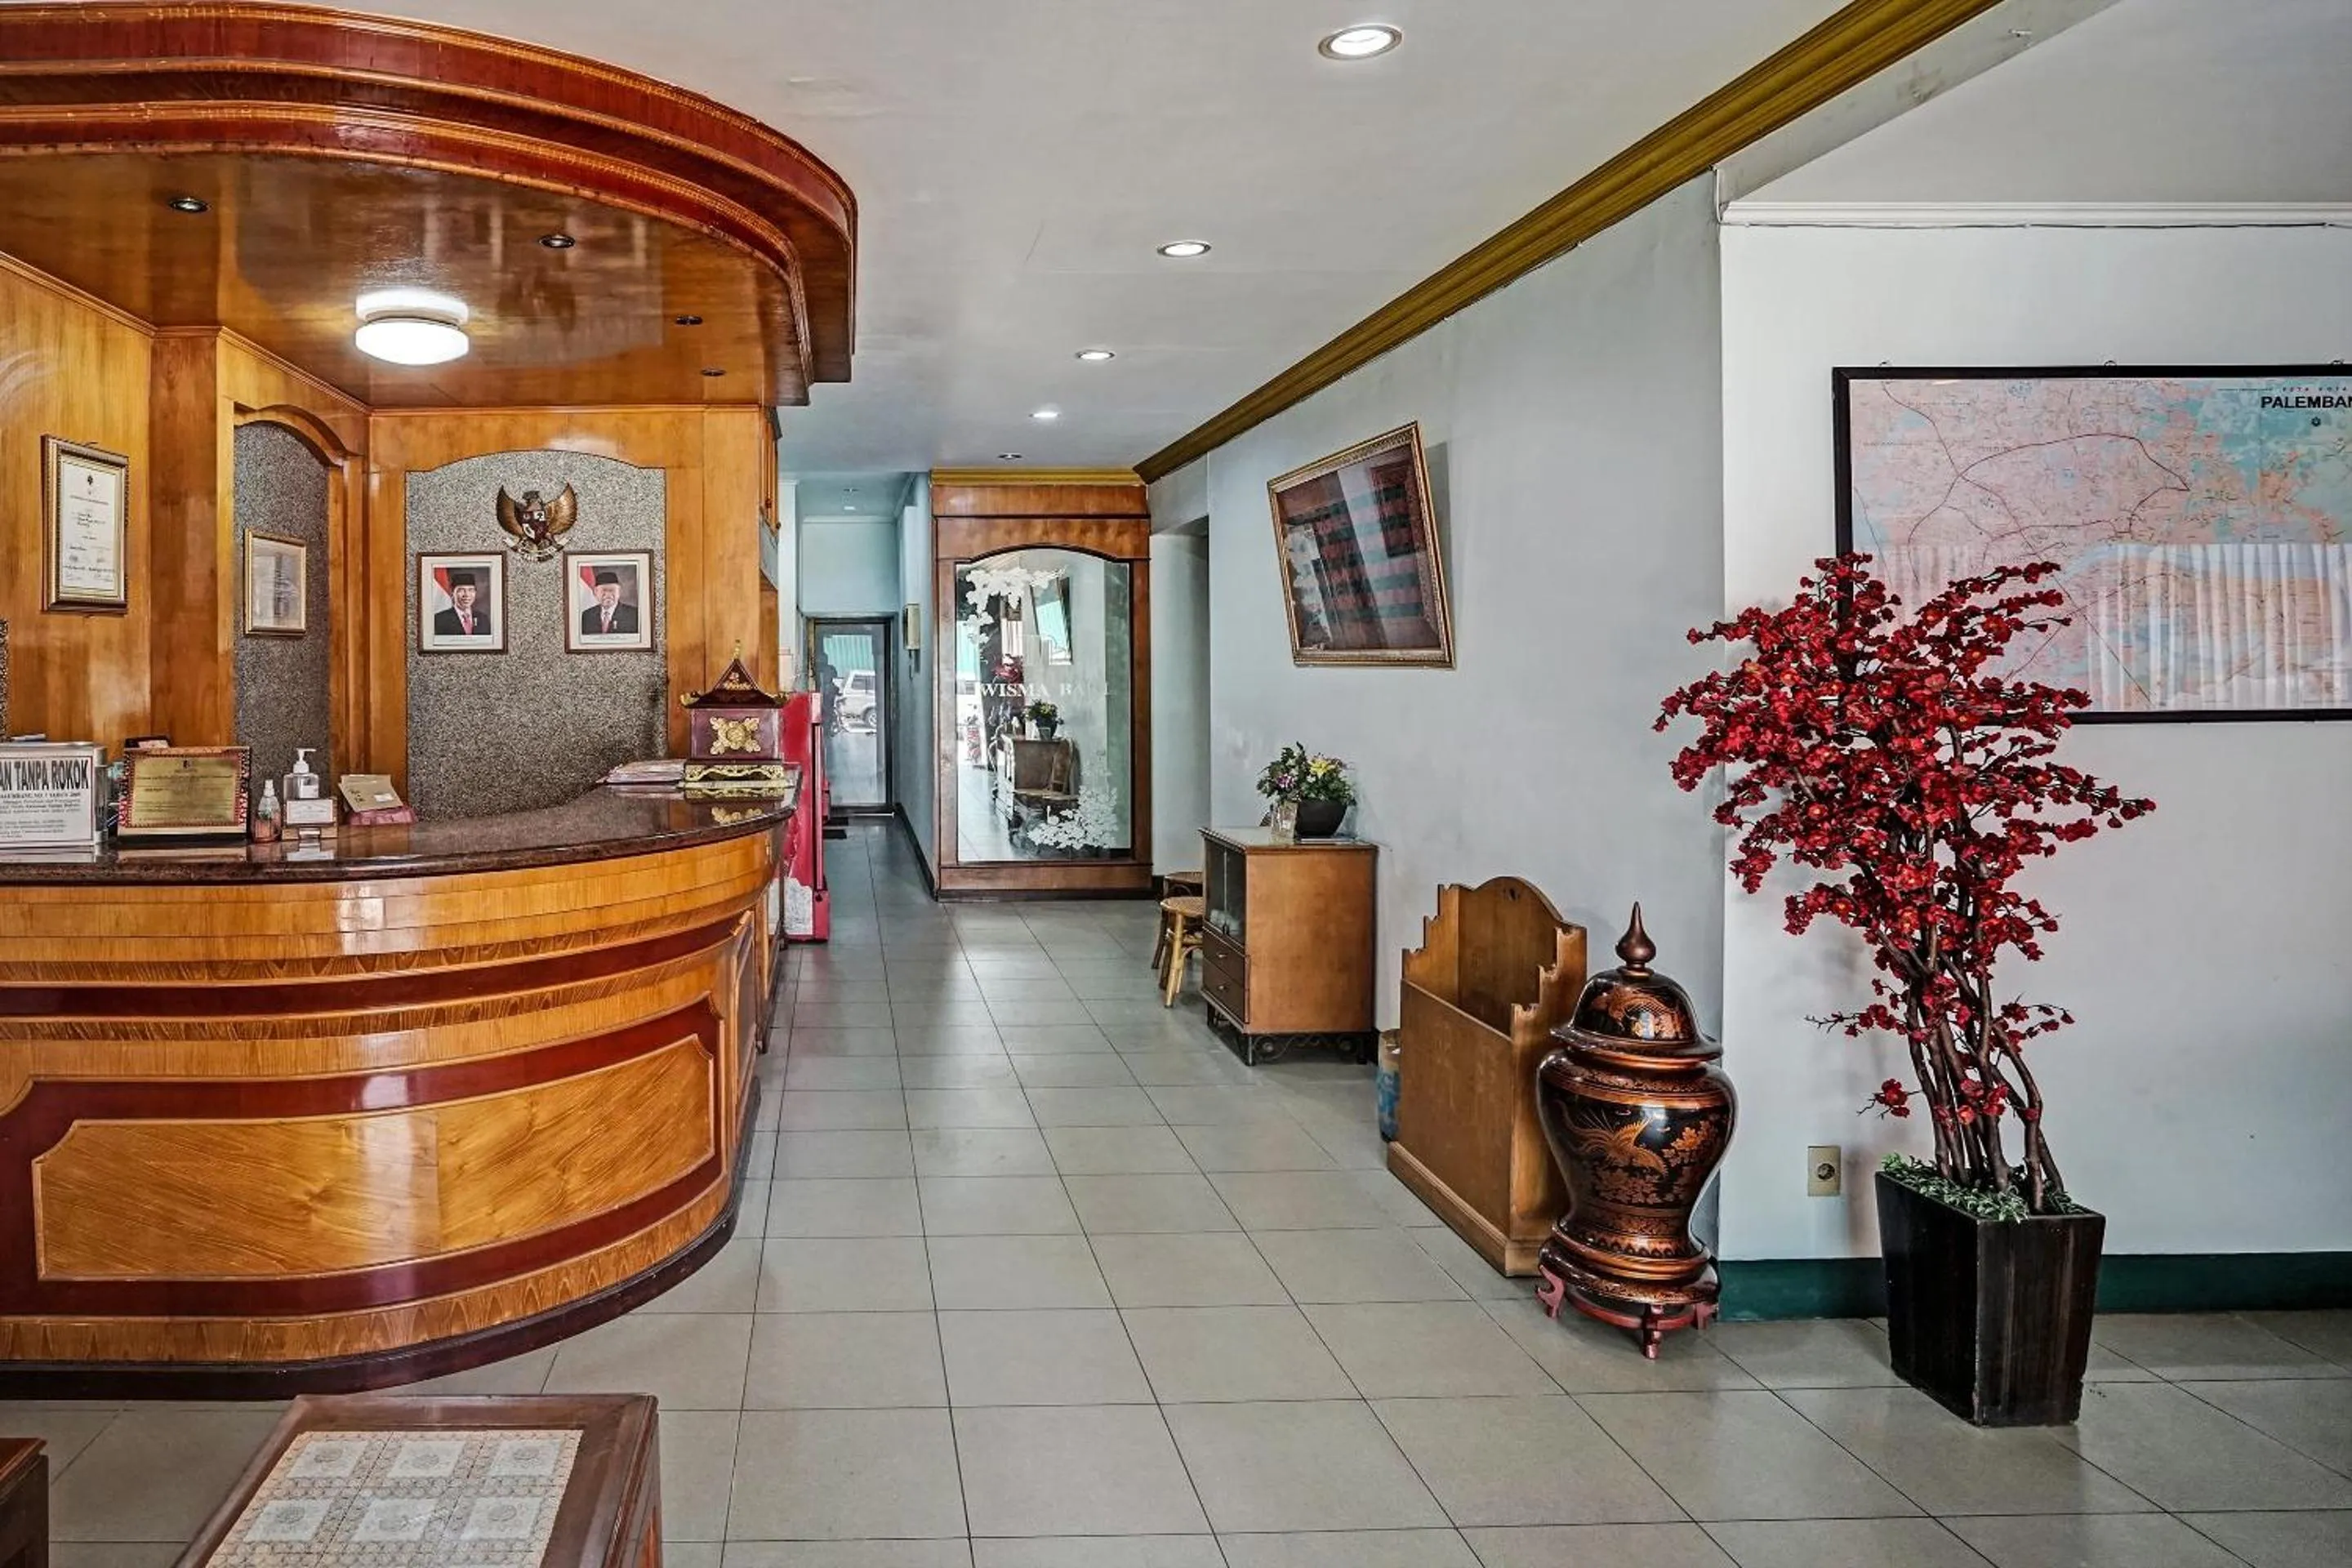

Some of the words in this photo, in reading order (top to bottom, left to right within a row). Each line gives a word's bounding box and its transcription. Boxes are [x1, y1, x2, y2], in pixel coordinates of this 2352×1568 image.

[981, 684, 1050, 696] WISMA
[14, 760, 49, 791] TANPA
[51, 760, 88, 790] ROKOK
